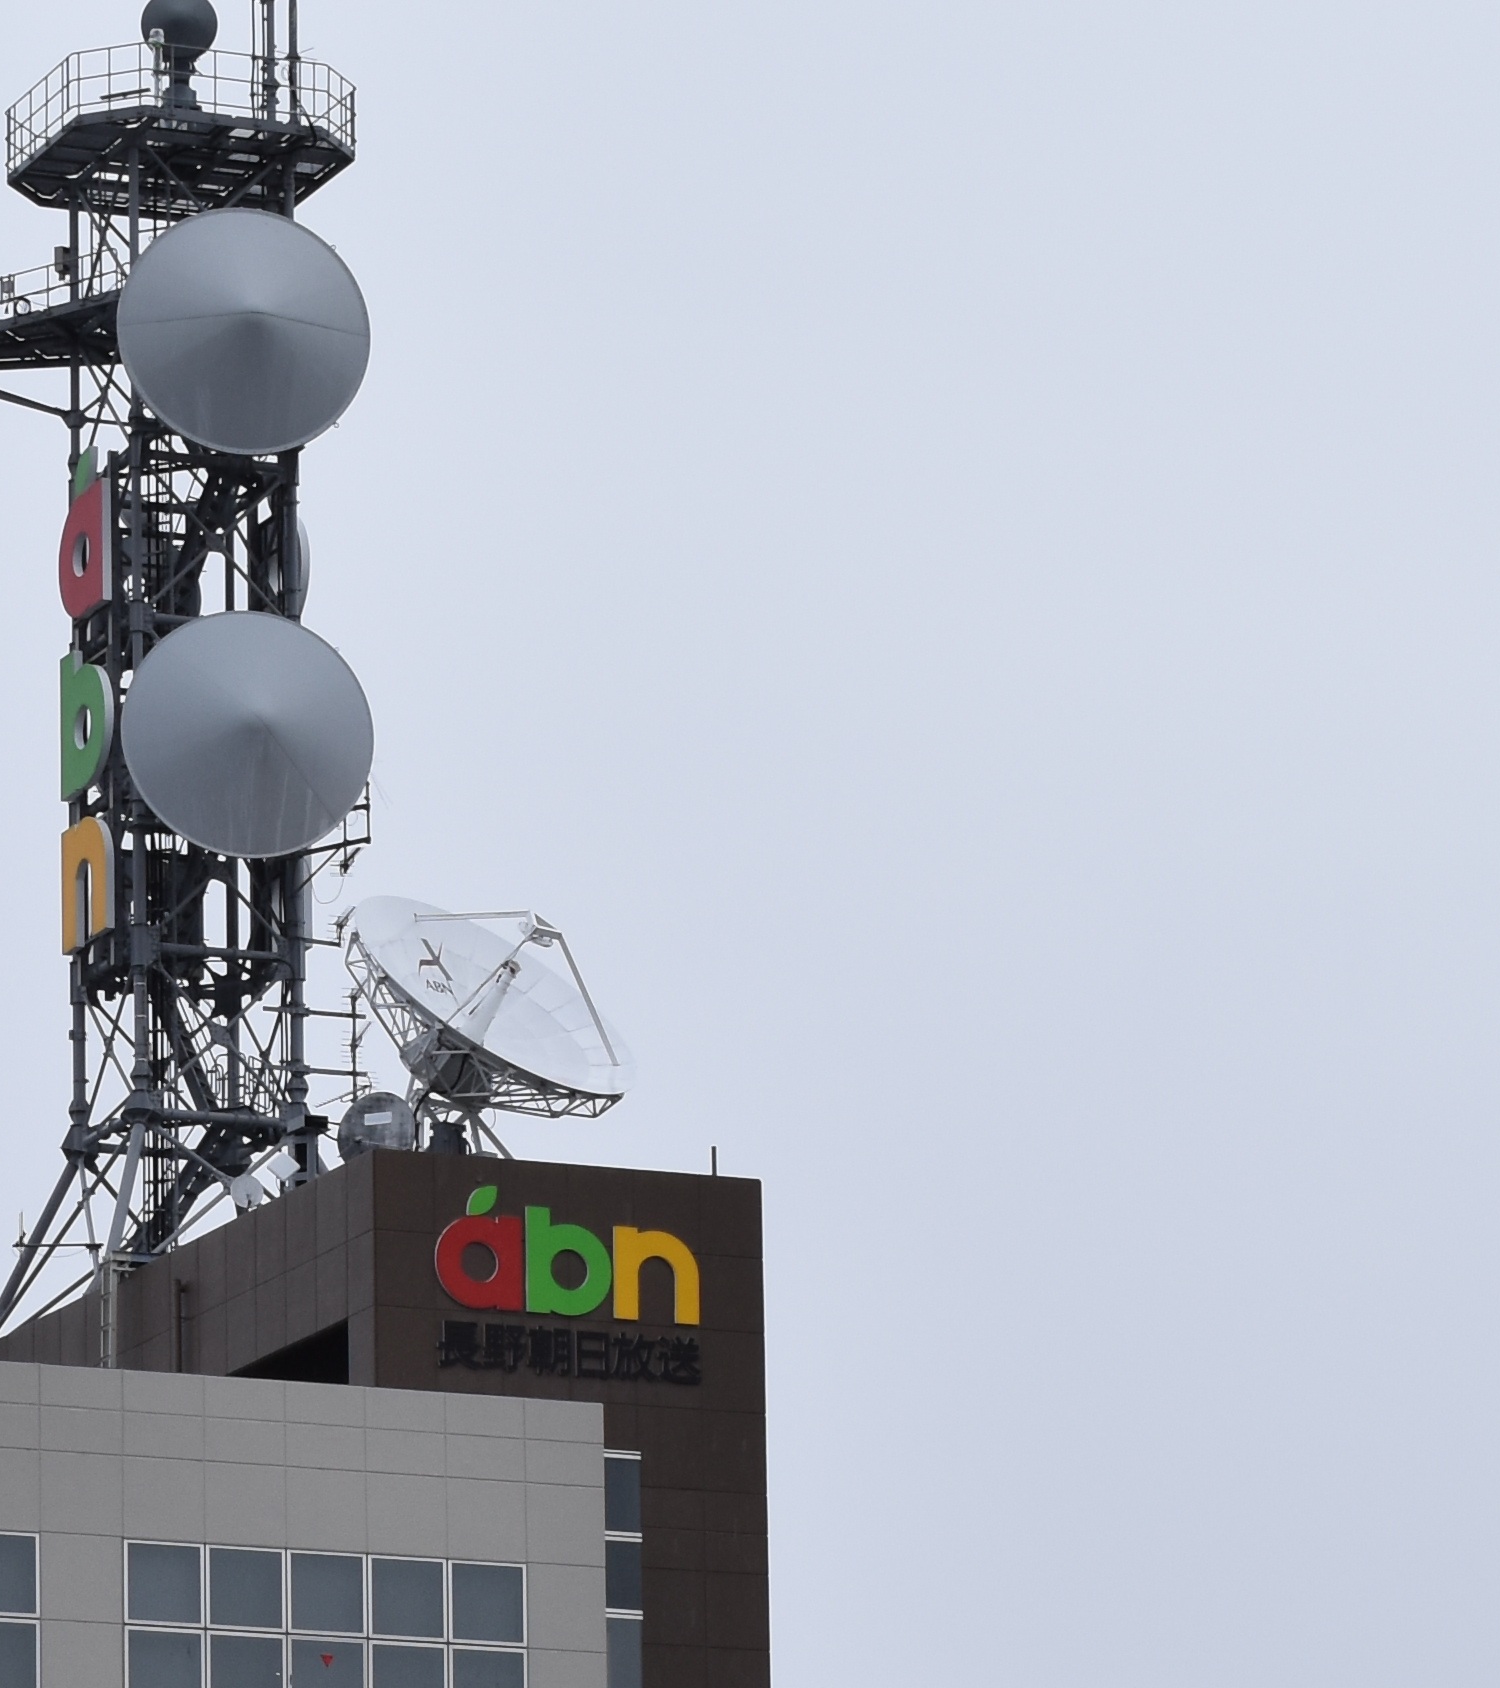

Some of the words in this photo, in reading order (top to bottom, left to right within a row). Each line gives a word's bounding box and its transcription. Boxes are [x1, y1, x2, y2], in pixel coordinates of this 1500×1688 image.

[425, 978, 456, 996] ABN
[434, 1200, 700, 1325] abn
[436, 1320, 701, 1385] 長野朝日放送
